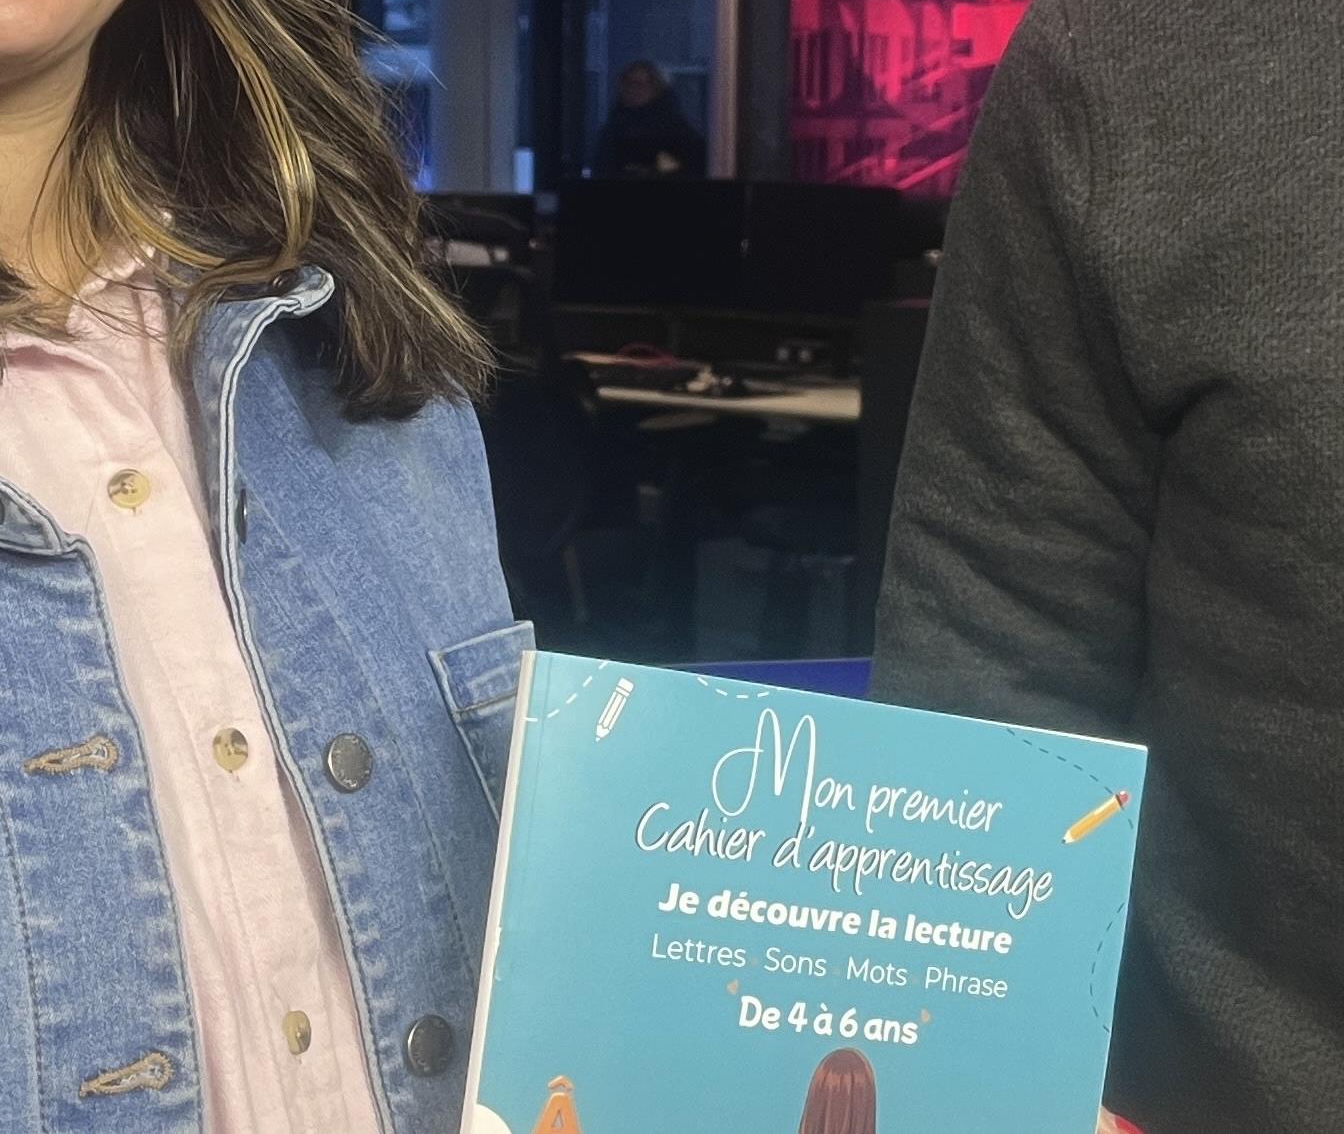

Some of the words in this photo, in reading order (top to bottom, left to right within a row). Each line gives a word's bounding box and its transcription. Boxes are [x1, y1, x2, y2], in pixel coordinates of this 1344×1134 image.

[712, 708, 856, 822] Mon
[865, 784, 1003, 834] premier
[636, 802, 766, 862] Cahier
[772, 821, 1054, 919] d'apprentissage
[658, 882, 700, 915] Je
[707, 889, 862, 935] découvre
[867, 909, 898, 940] la
[904, 913, 1013, 954] lecture
[651, 933, 747, 968] Lettres
[764, 947, 828, 977] Sons
[846, 956, 908, 987] Mots
[925, 966, 1009, 999] Phrase
[738, 995, 782, 1030] De
[787, 1002, 808, 1033] 4
[813, 1002, 833, 1037] à
[839, 1007, 859, 1039] 6
[863, 1017, 919, 1045] ans
